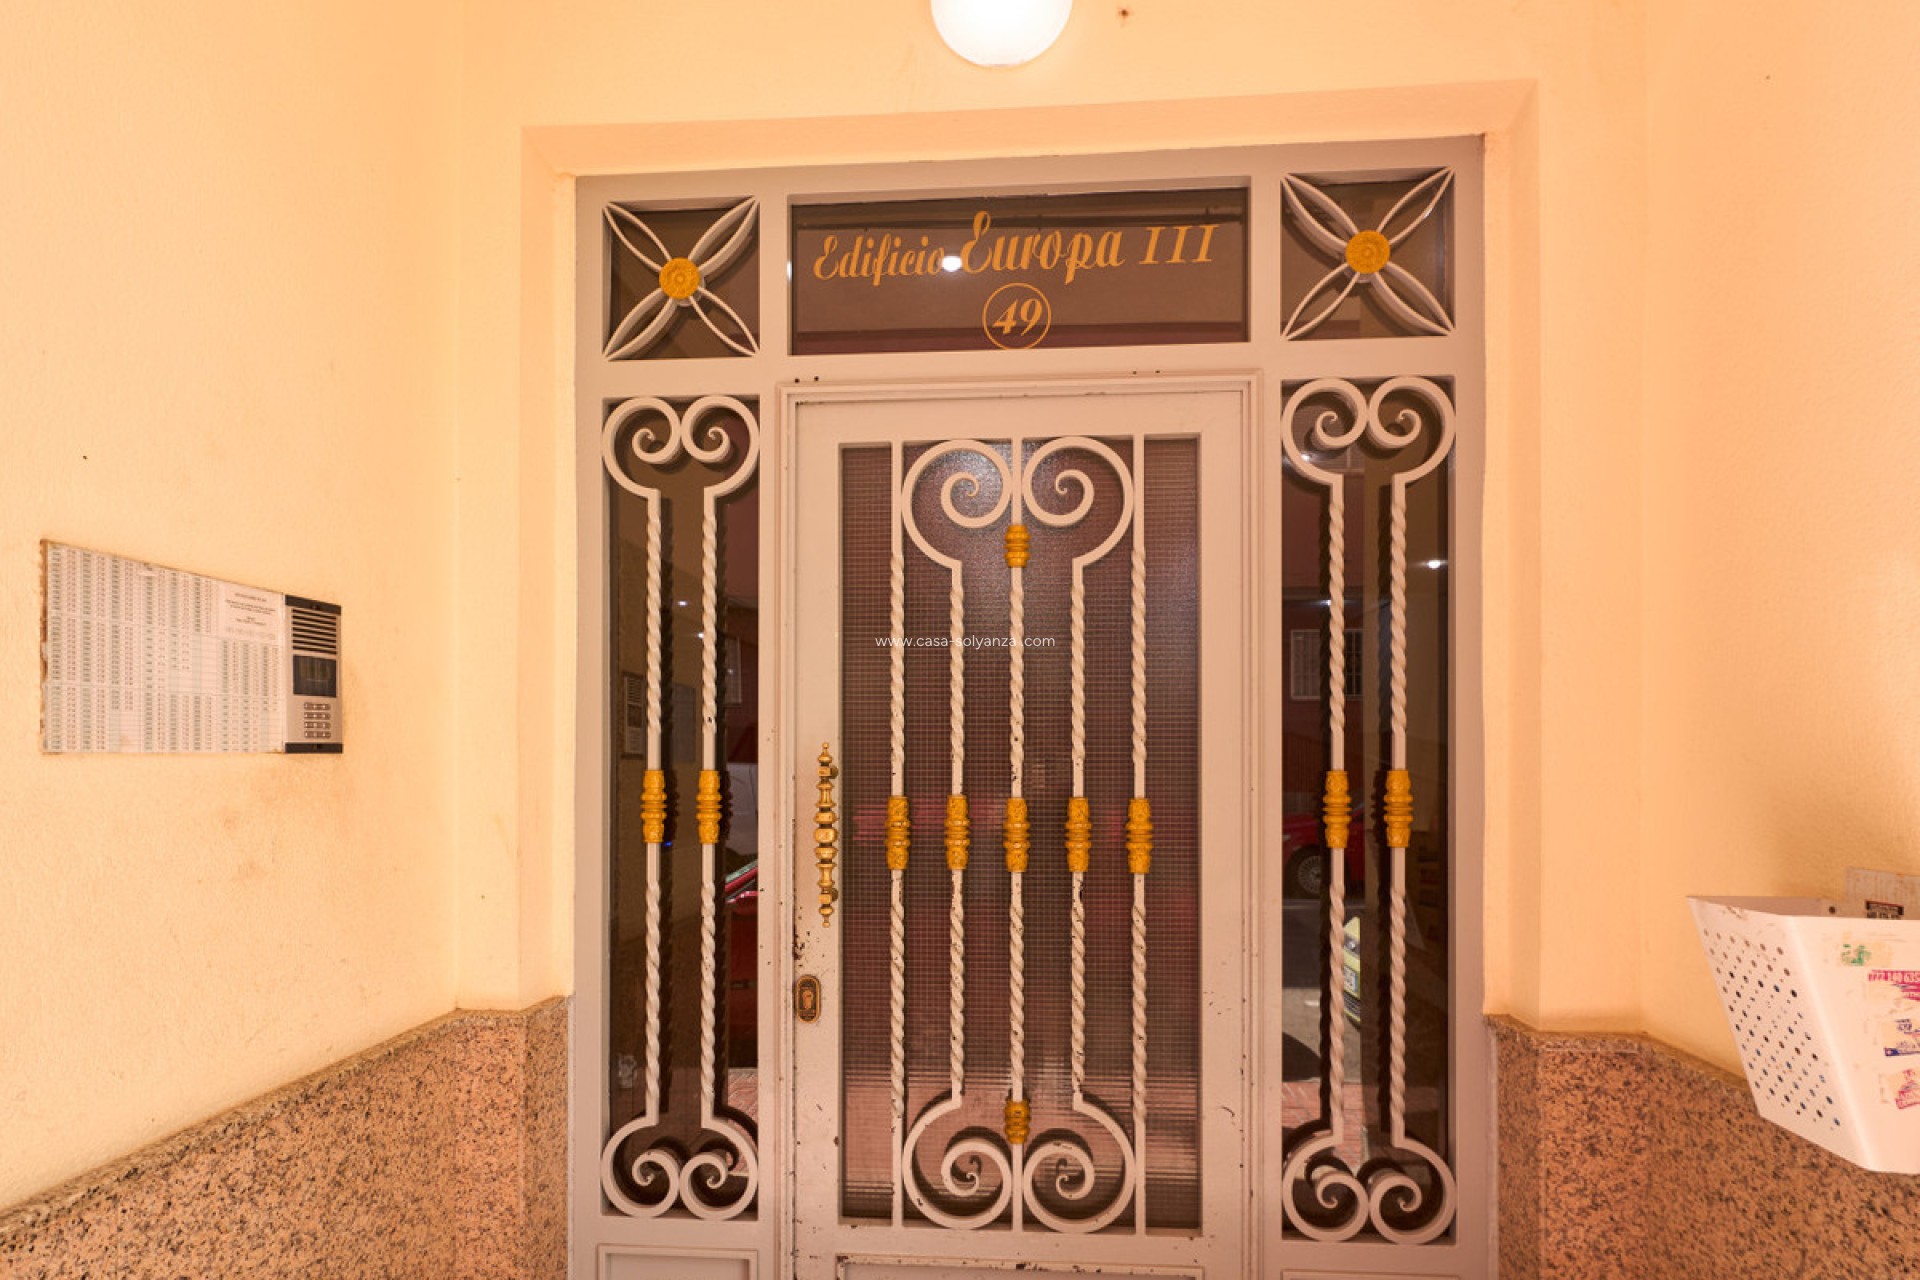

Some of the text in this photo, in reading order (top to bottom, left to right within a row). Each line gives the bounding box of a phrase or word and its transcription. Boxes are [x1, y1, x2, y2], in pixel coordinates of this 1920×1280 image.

[814, 210, 1220, 287] Edificio Europa III
[992, 298, 1043, 336] 49
